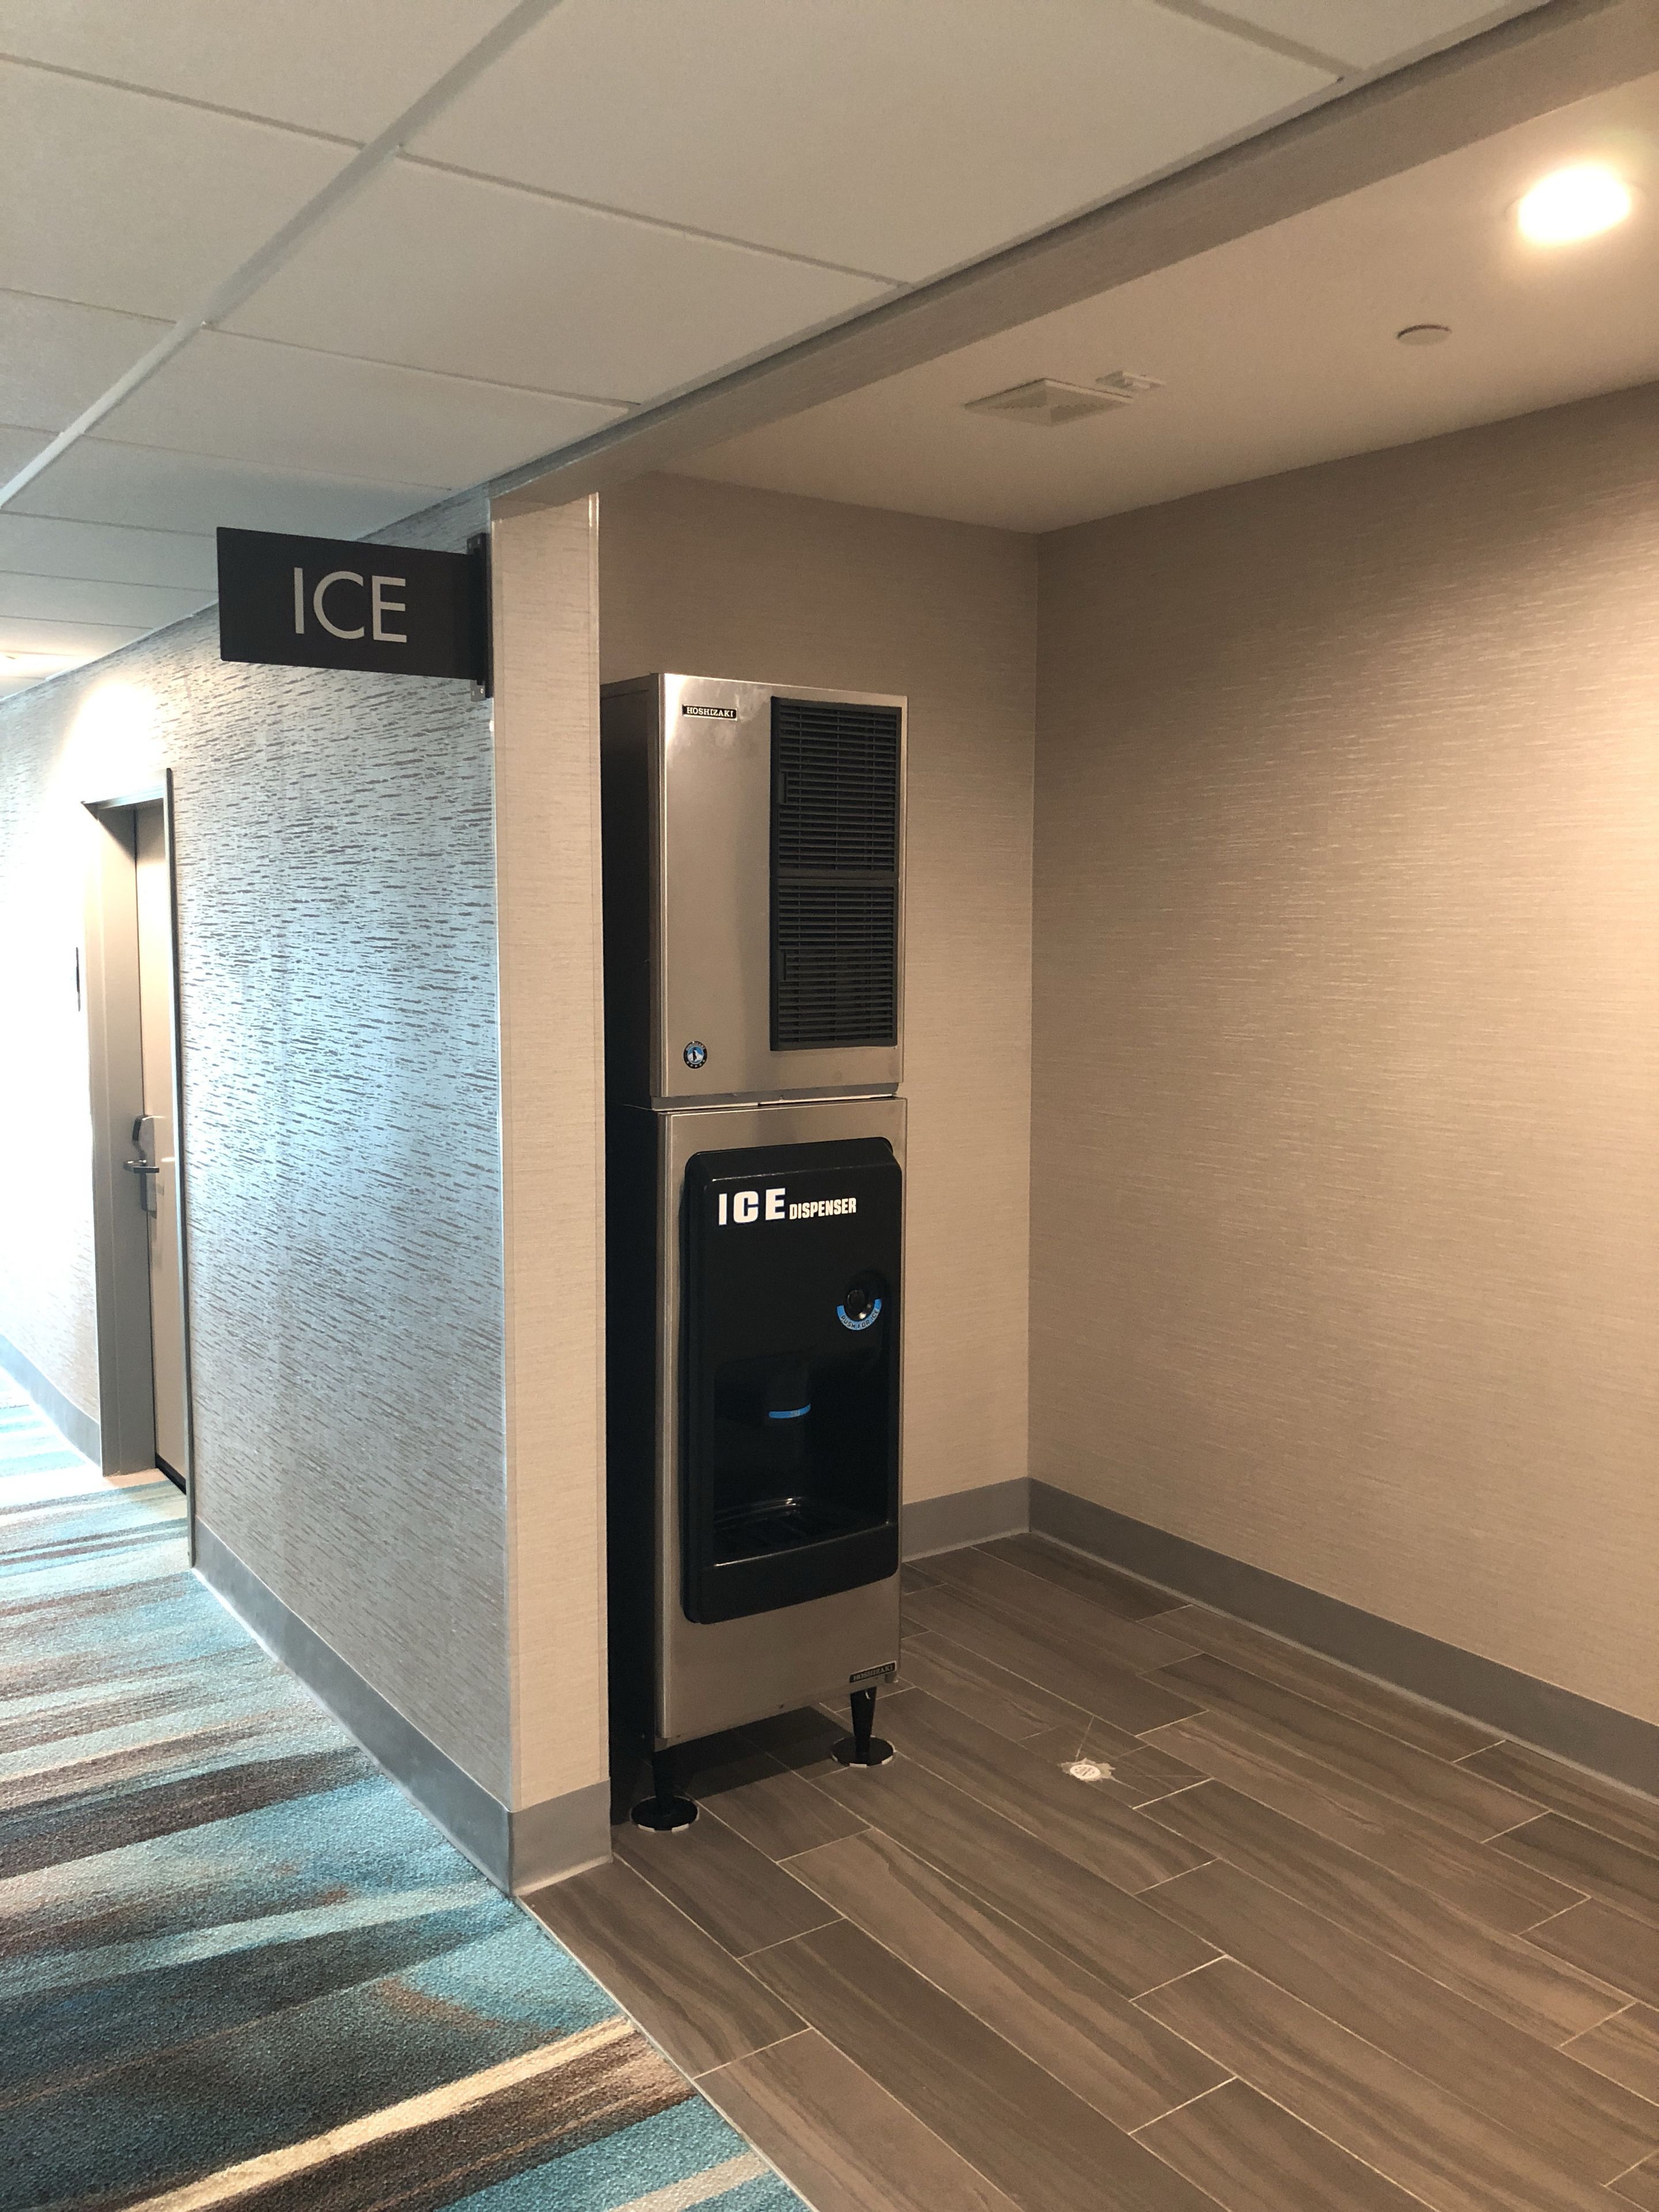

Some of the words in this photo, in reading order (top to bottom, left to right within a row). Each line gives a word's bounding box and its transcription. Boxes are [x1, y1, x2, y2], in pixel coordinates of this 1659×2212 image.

[294, 567, 407, 643] ICE
[687, 707, 734, 717] HOSHIZAKI
[718, 1188, 786, 1225] ICE
[789, 1198, 857, 1219] DISPENSER
[840, 1315, 855, 1328] PUSH
[858, 1320, 870, 1328] FOR
[870, 1309, 879, 1320] ICE
